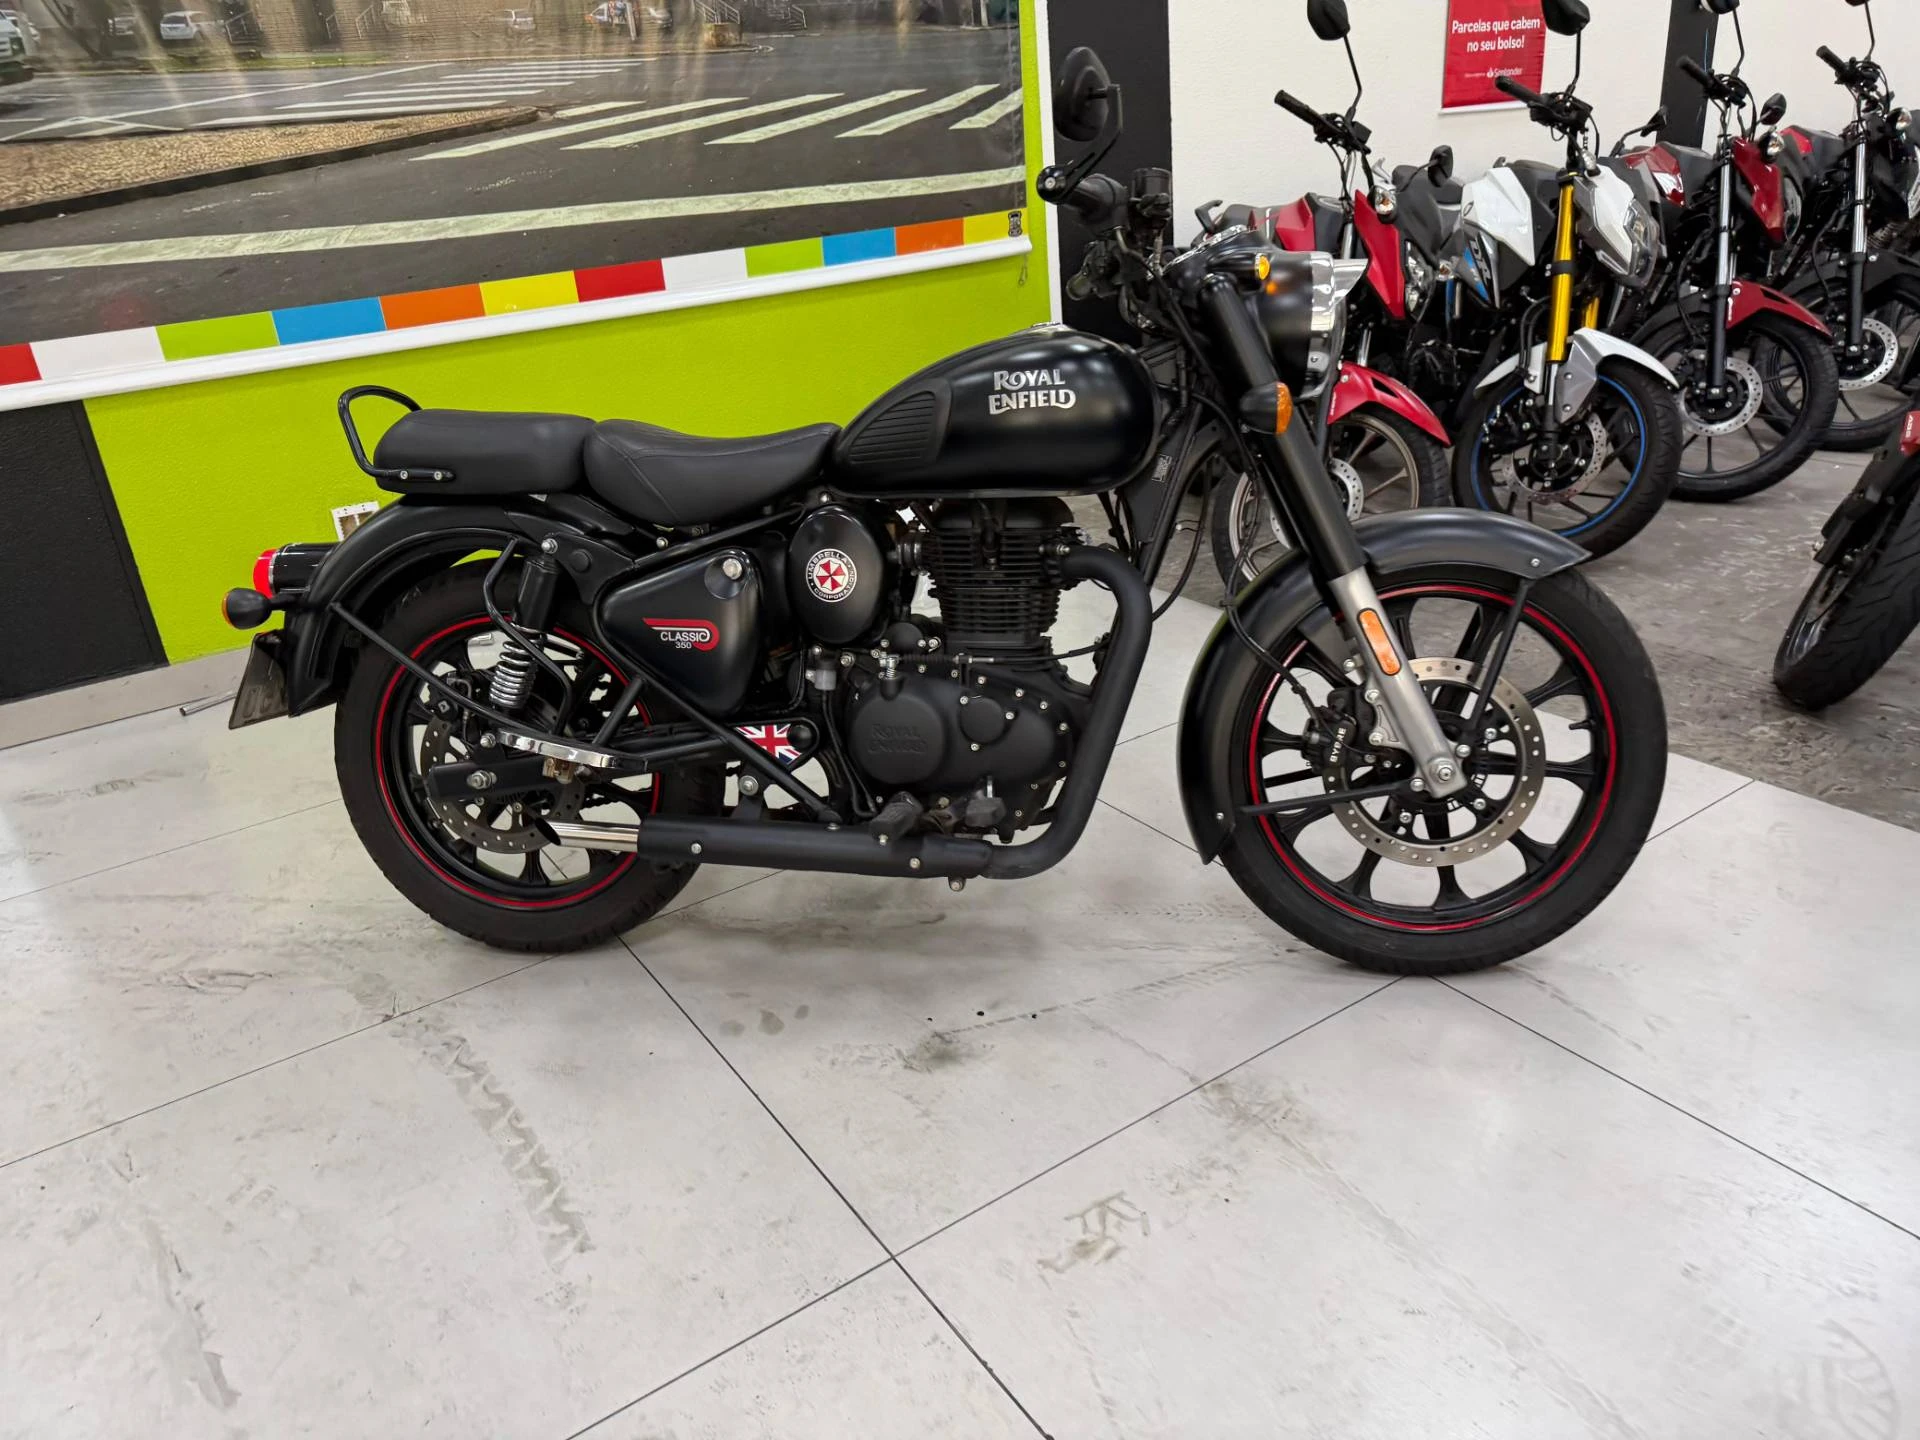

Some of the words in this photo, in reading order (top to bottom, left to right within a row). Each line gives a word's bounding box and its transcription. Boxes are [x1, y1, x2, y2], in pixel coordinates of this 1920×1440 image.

[1452, 18, 1491, 34] Parcelas
[1492, 21, 1509, 34] que
[1511, 16, 1541, 30] cabem
[1467, 41, 1479, 53] no
[1480, 40, 1496, 51] seu
[1497, 35, 1525, 50] bolso!
[993, 368, 1066, 391] ROYAL
[988, 388, 1077, 415] ENFIELD
[807, 551, 850, 580] UMBRELLA
[814, 570, 855, 600] CORPORATION
[660, 631, 711, 643] CLASSIC
[675, 641, 692, 649] 350
